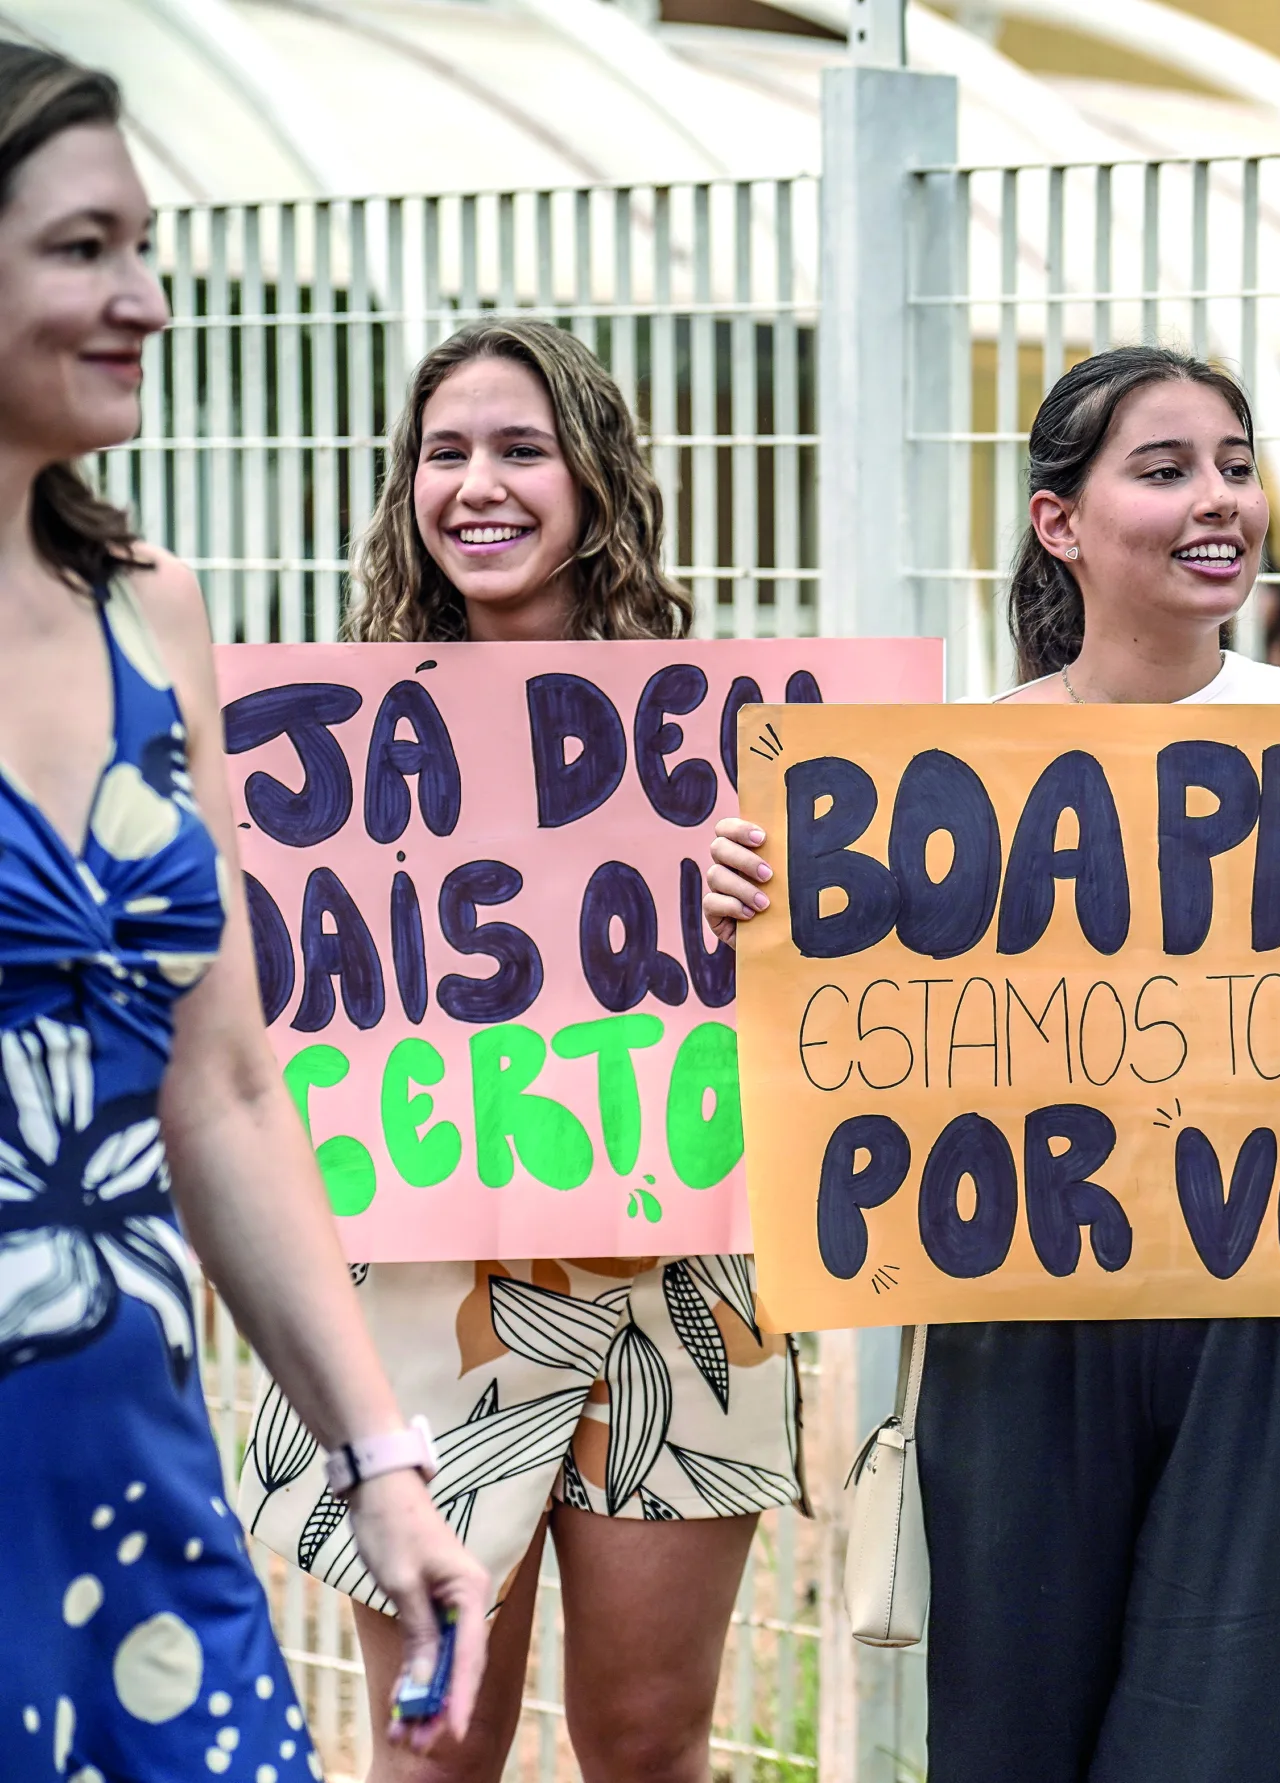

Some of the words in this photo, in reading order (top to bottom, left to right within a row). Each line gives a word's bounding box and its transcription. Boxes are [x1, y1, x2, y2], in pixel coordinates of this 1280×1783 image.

[221, 659, 462, 847] JÁ
[786, 747, 1130, 960] BOA
[283, 1012, 744, 1217] CERTO
[799, 976, 1188, 1091] ESTAMOS
[817, 1103, 1133, 1279] POR
